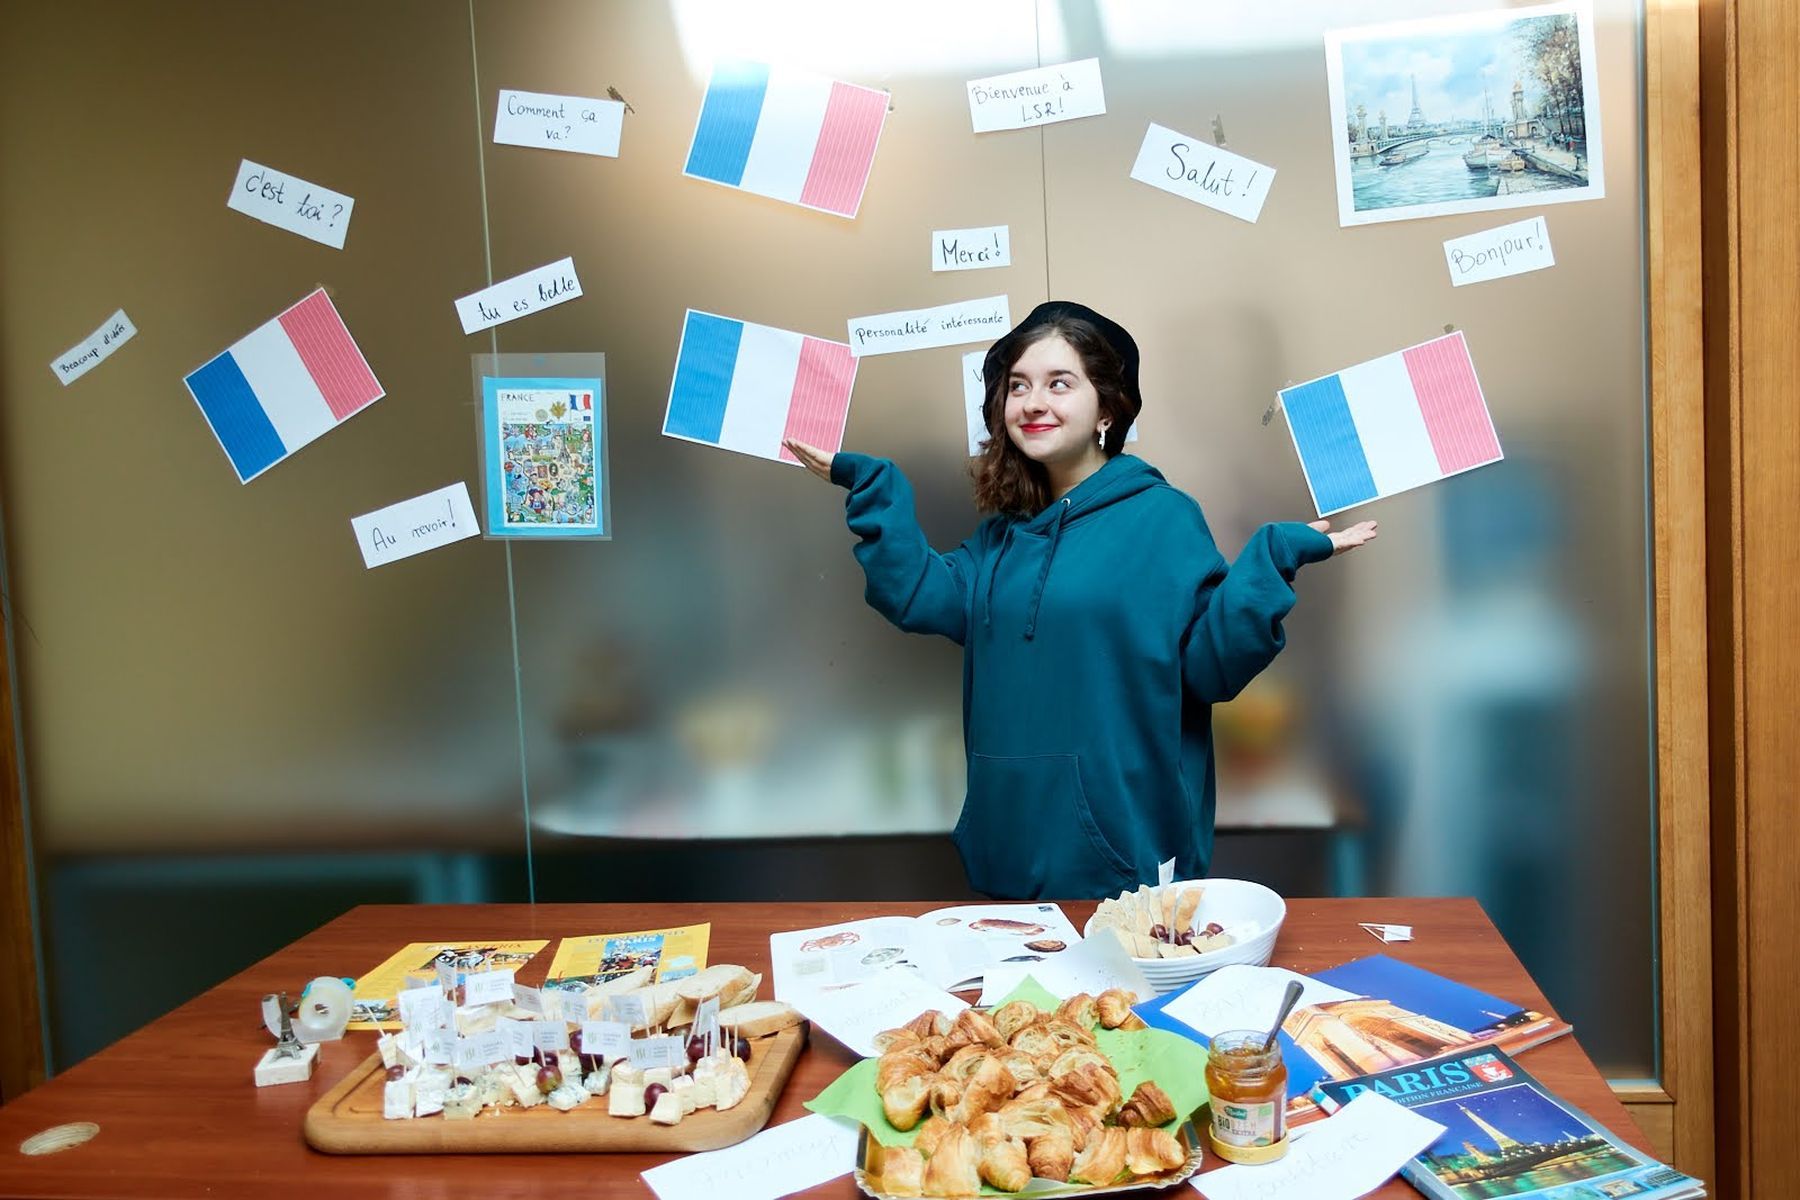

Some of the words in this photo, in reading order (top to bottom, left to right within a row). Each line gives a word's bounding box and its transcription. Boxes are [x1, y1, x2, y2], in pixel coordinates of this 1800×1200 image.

[971, 82, 1049, 105] Bienvenue
[1059, 71, 1074, 92] à
[507, 95, 565, 119] Comment
[581, 109, 597, 122] ça
[1021, 96, 1065, 122] LSR!
[941, 232, 1001, 266] Merci!
[1451, 221, 1544, 274] Bonjour!
[538, 276, 576, 302] belle
[501, 393, 535, 402] FRANCE
[372, 526, 397, 552] Au
[411, 498, 456, 539] revoir!
[1340, 1061, 1470, 1101] PARIS
